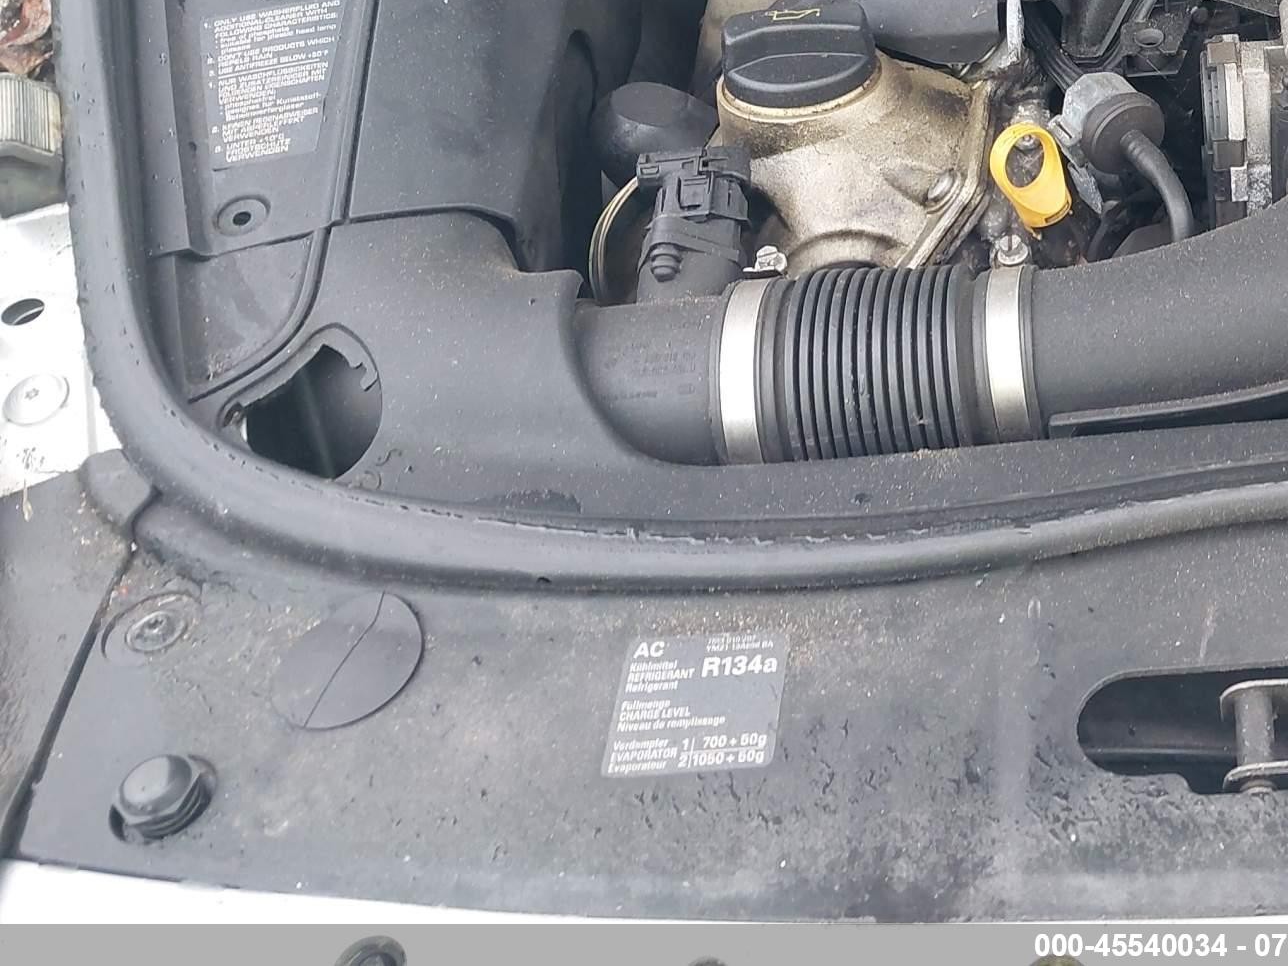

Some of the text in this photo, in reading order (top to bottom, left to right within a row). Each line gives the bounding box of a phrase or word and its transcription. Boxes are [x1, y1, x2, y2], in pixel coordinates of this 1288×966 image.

[214, 17, 238, 27] ONLY
[239, 13, 256, 23] USE
[321, 0, 341, 9] AND
[305, 7, 328, 17] WITH
[215, 23, 263, 39] FOLLOWING
[295, 26, 316, 35] head
[317, 23, 337, 33] lamp
[261, 40, 305, 53] PRODUCTS
[307, 35, 335, 47] WHICH
[252, 53, 273, 61] RAIN
[279, 52, 306, 64] BELOW
[633, 640, 665, 659] AC
[701, 654, 778, 677] R134a
[627, 667, 696, 683] REFRIGERANT
[625, 680, 679, 694] Refrigerant
[619, 706, 691, 722] CHARGE LEVEL
[617, 714, 726, 733] Niveau de remplissage
[703, 735, 727, 748] 700
[611, 746, 678, 763] EVAPORATOR
[692, 750, 727, 766] 1050
